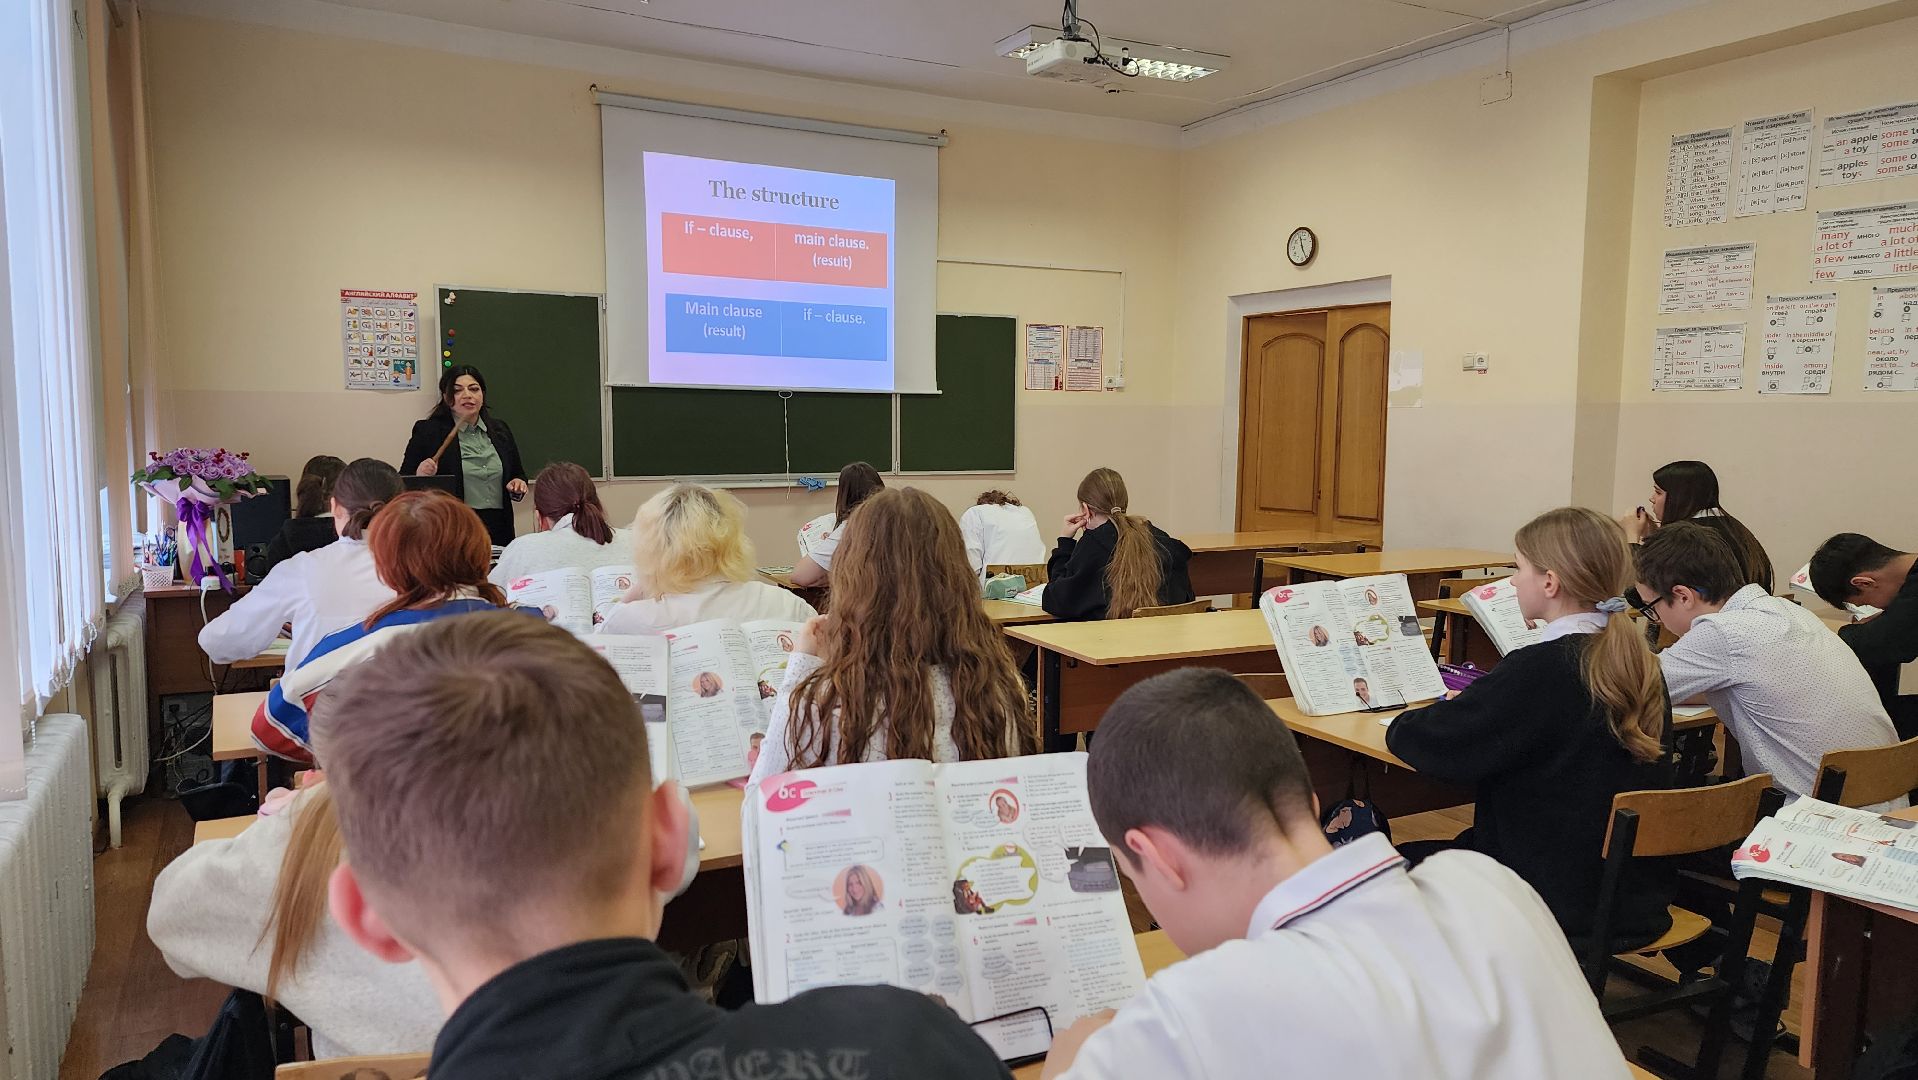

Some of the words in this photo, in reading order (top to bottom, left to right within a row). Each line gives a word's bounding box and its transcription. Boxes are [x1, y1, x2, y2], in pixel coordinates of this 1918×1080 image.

[1851, 133, 1878, 144] apple
[1881, 129, 1908, 139] some
[1852, 145, 1869, 153] toy
[1882, 140, 1909, 149] some
[1837, 160, 1868, 171] apples
[1881, 154, 1907, 164] some
[1842, 171, 1862, 179] toys
[1877, 165, 1903, 174] some
[709, 180, 746, 200] The
[752, 186, 839, 210] structure
[684, 221, 694, 234] If
[709, 222, 753, 242] clause,
[1821, 231, 1850, 240] many
[795, 232, 825, 247] main
[829, 233, 869, 250] clause.
[1826, 242, 1839, 250] lot
[1842, 240, 1853, 249] of
[1890, 236, 1905, 245] lot
[1824, 255, 1844, 263] few
[1894, 247, 1918, 257] little
[813, 253, 852, 270] (result)
[1893, 263, 1918, 272] little
[1816, 270, 1835, 279] few
[686, 302, 719, 316] Main
[723, 303, 762, 318] clause
[803, 308, 812, 321] if
[825, 309, 866, 324] clause.
[704, 323, 746, 340] (result)
